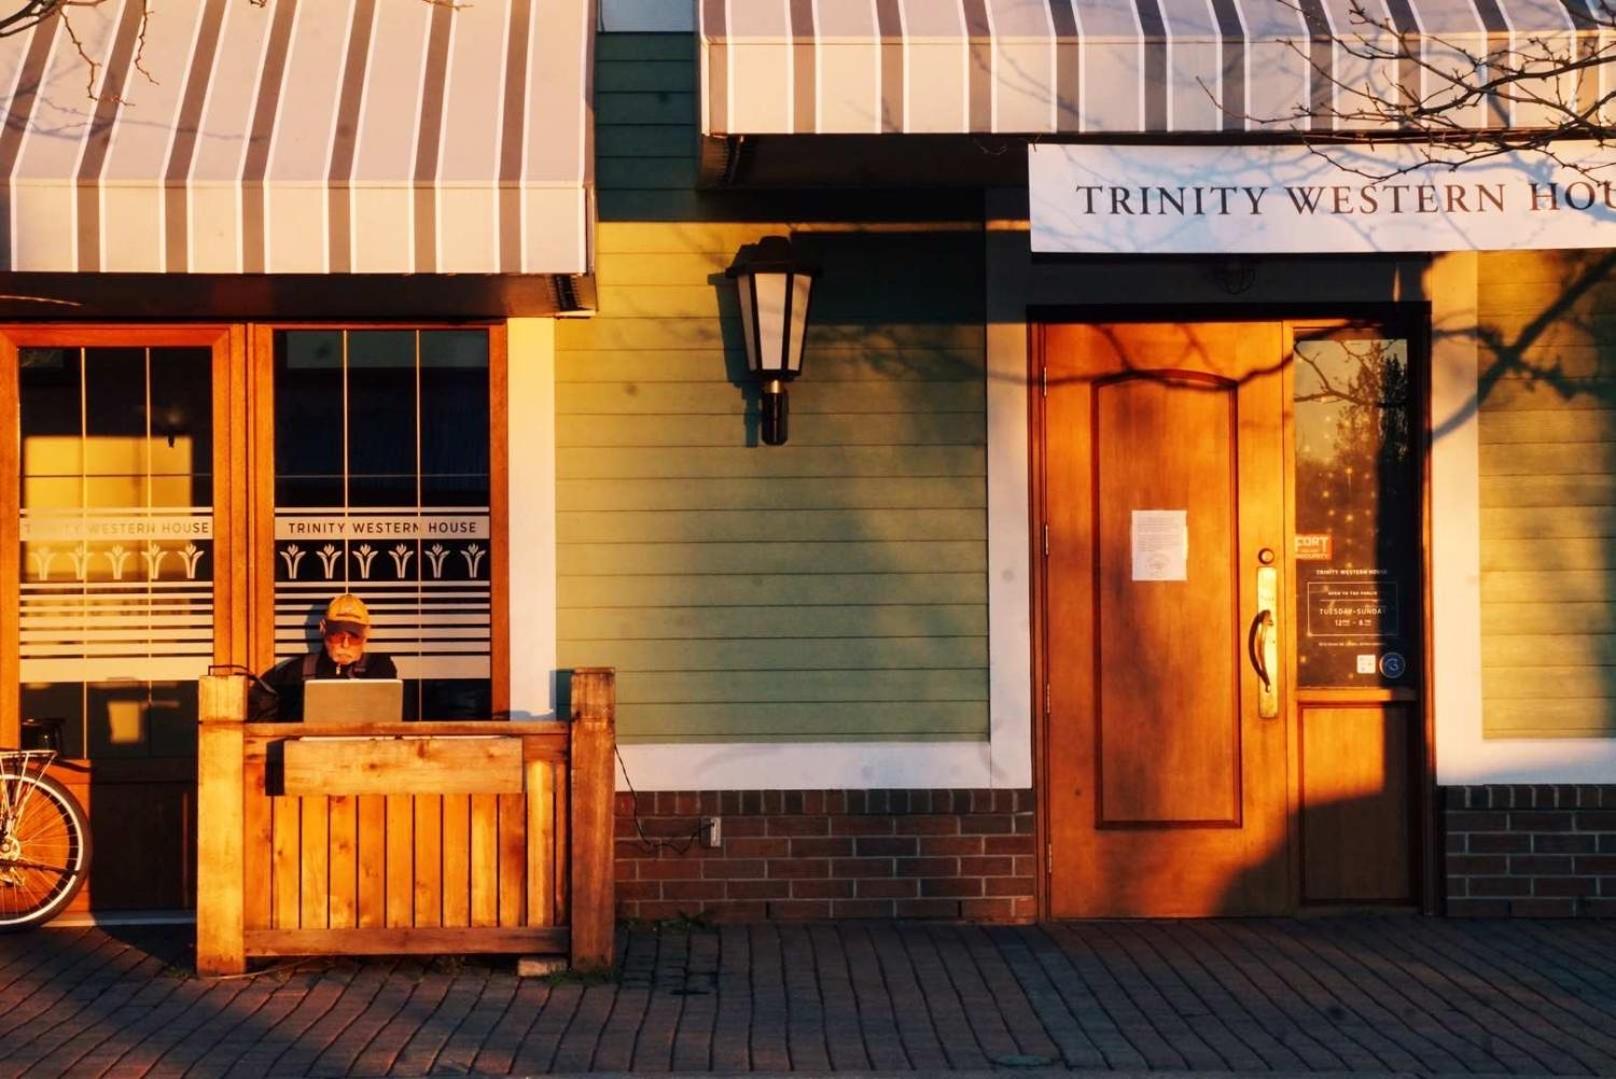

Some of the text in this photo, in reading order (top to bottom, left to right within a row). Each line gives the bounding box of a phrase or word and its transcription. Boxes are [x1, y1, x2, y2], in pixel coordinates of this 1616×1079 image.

[1075, 184, 1268, 216] TRINITY
[1285, 182, 1506, 215] WESTERN
[161, 521, 209, 534] HOUSE
[288, 521, 477, 534] TRINITY WESTERN HOUSE
